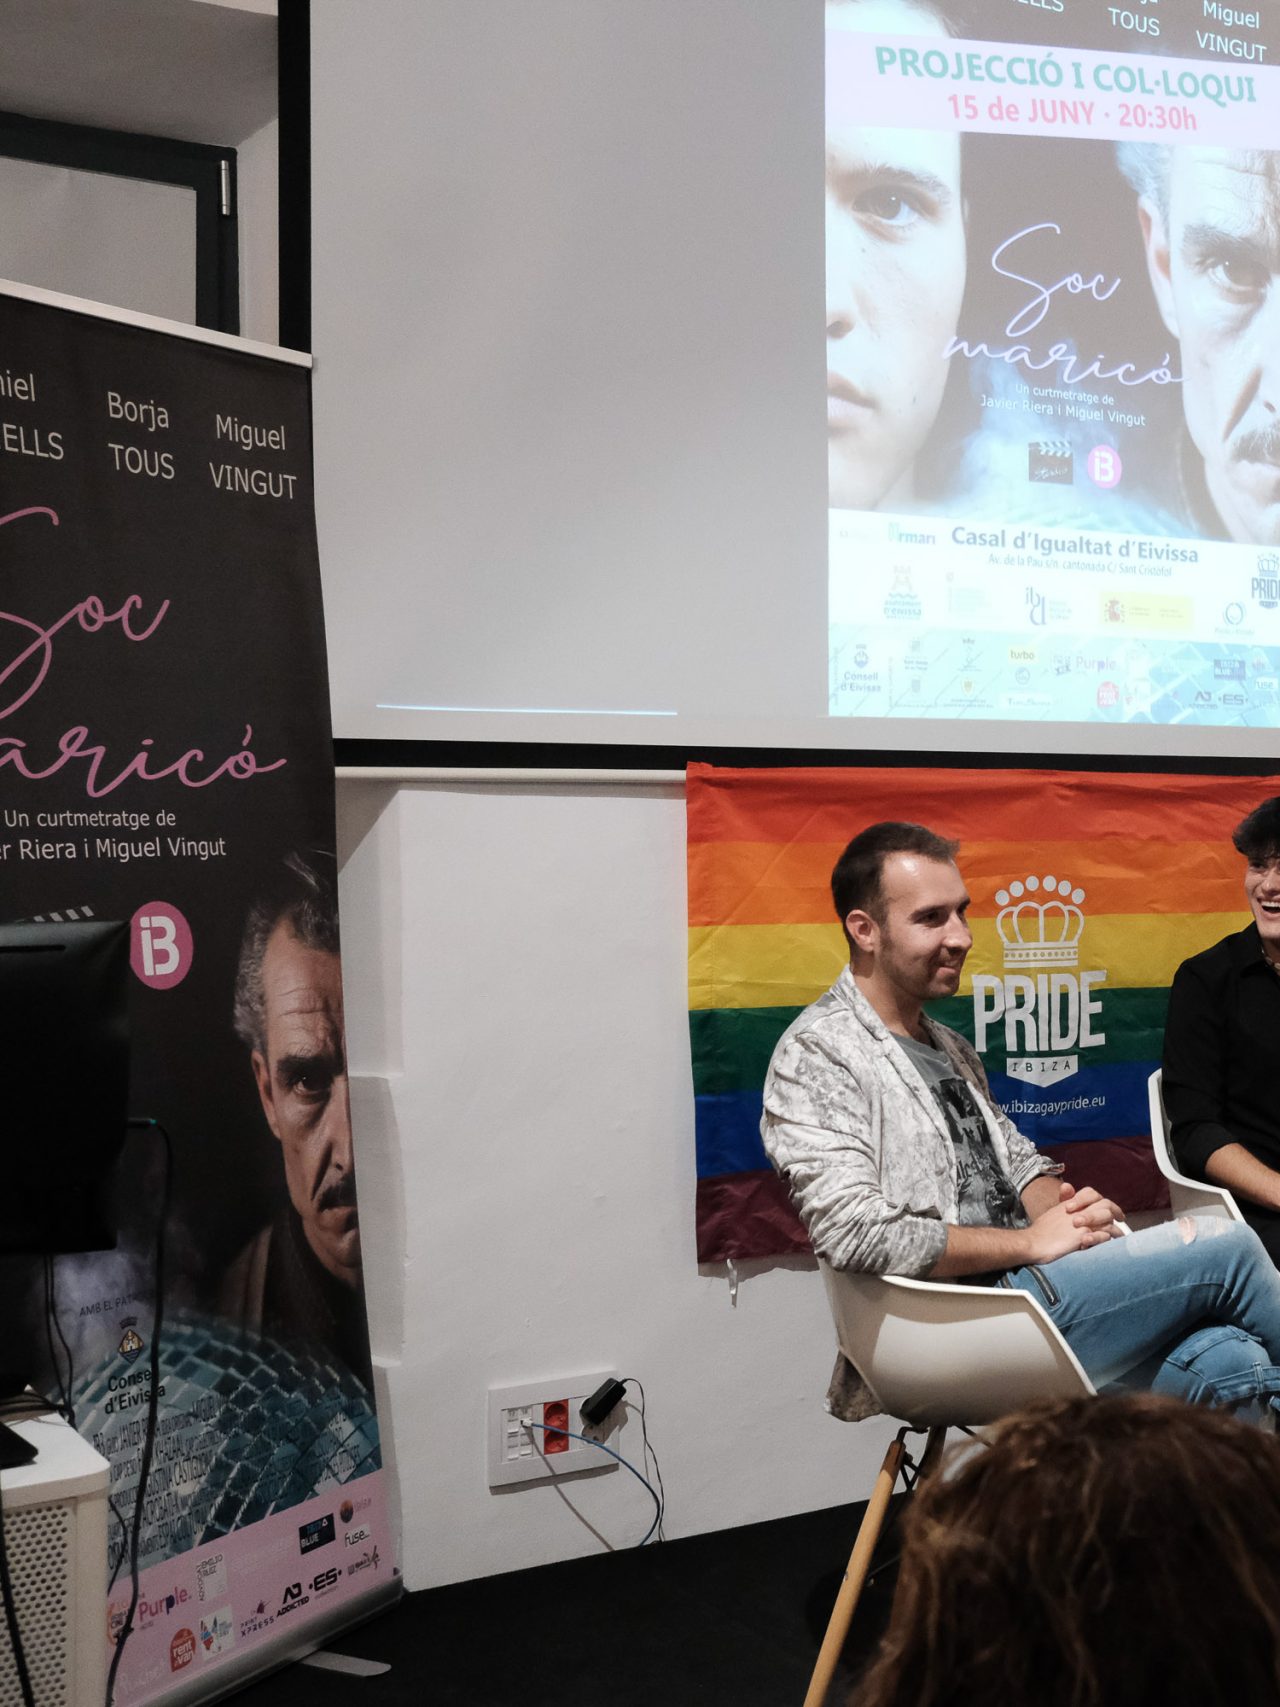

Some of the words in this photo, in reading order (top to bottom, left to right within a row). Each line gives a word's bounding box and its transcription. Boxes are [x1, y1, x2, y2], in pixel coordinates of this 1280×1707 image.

[1107, 7, 1161, 37] TOUS
[1202, 2, 1260, 30] Miguel
[1195, 29, 1267, 63] VINGUT
[874, 45, 1064, 88] PROJECCIÓ
[1072, 62, 1086, 90] I
[946, 94, 979, 121] 15
[987, 95, 1020, 123] de
[1027, 98, 1095, 126] JUNY
[1117, 103, 1198, 131] 20:30h
[1015, 383, 1030, 395] Un
[1101, 394, 1115, 406] de
[107, 391, 170, 433] Borja
[979, 393, 1018, 410] Javier
[1021, 399, 1054, 416] Riera
[1065, 405, 1105, 422] Miguel
[1107, 410, 1147, 428] Vingut
[215, 414, 287, 451] Miguel
[107, 443, 176, 480] TOUS
[208, 462, 297, 500] VINGUT
[951, 526, 1007, 548] Casal
[1119, 562, 1137, 576] Sant
[843, 671, 879, 682] Consell
[3, 810, 31, 828] Un
[36, 809, 151, 832] curtmetratge
[155, 808, 177, 828] de
[18, 838, 78, 861] Riera
[83, 837, 90, 859] i
[95, 837, 162, 863] Miguel
[167, 837, 227, 862] Vingut
[970, 969, 1108, 1054] PRIDE
[1011, 1059, 1071, 1073] IBIZA
[79, 1302, 102, 1318] AMB
[103, 1300, 114, 1312] EL
[104, 1384, 167, 1415] d'Eivisa
[275, 1595, 310, 1619] ADDICTED
